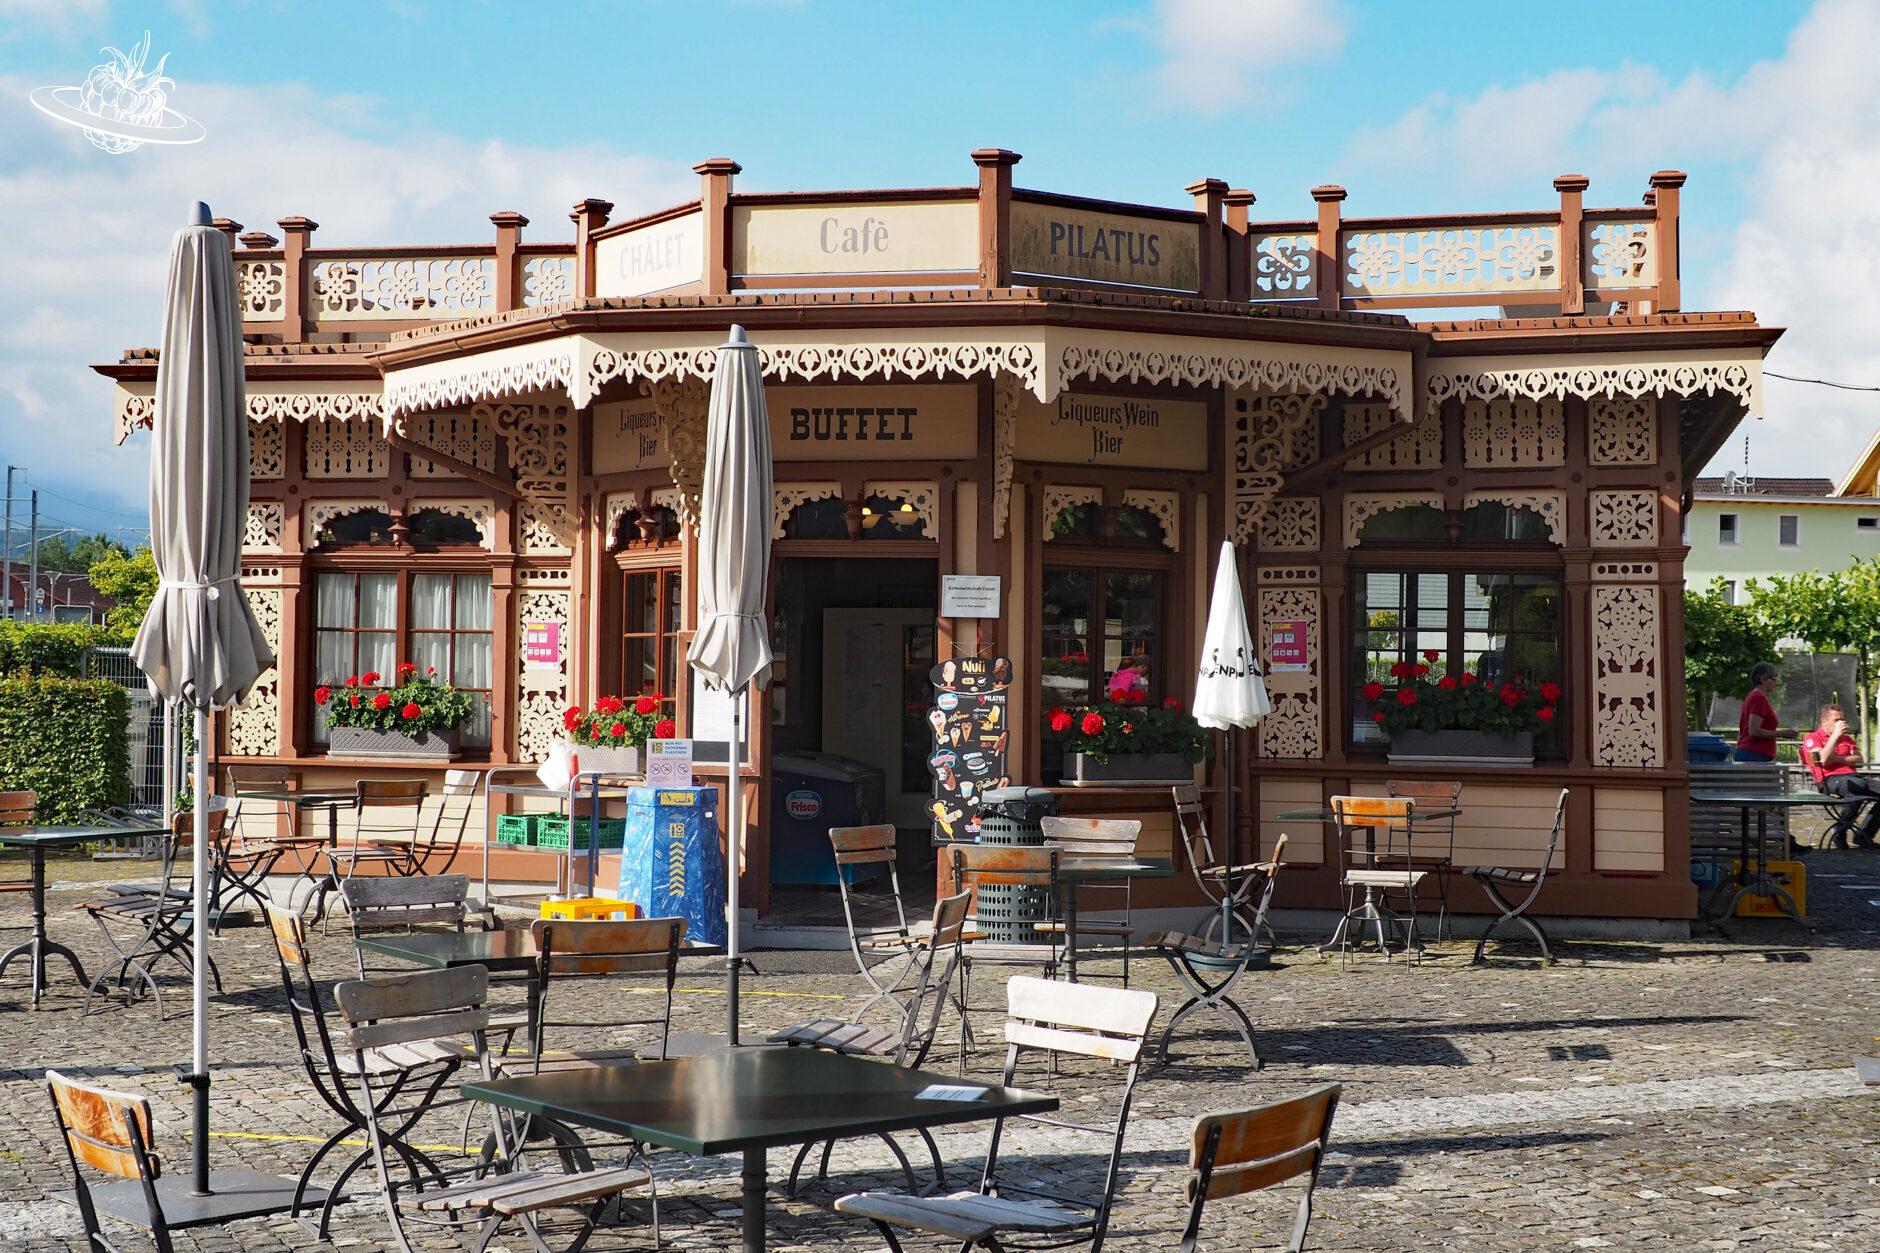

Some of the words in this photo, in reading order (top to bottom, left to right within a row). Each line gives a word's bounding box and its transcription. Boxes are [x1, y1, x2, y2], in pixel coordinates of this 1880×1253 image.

[820, 217, 889, 256] Cafè
[1050, 221, 1161, 267] PILATUS
[620, 233, 685, 280] CHÂLET
[616, 408, 657, 438] Liqueurs
[790, 407, 918, 441] BUFFET
[1050, 395, 1122, 428] Liqueurs
[1119, 401, 1159, 431] Wein
[636, 432, 658, 469] Bier
[1087, 426, 1123, 464] Bier
[790, 801, 818, 813] Frisco
